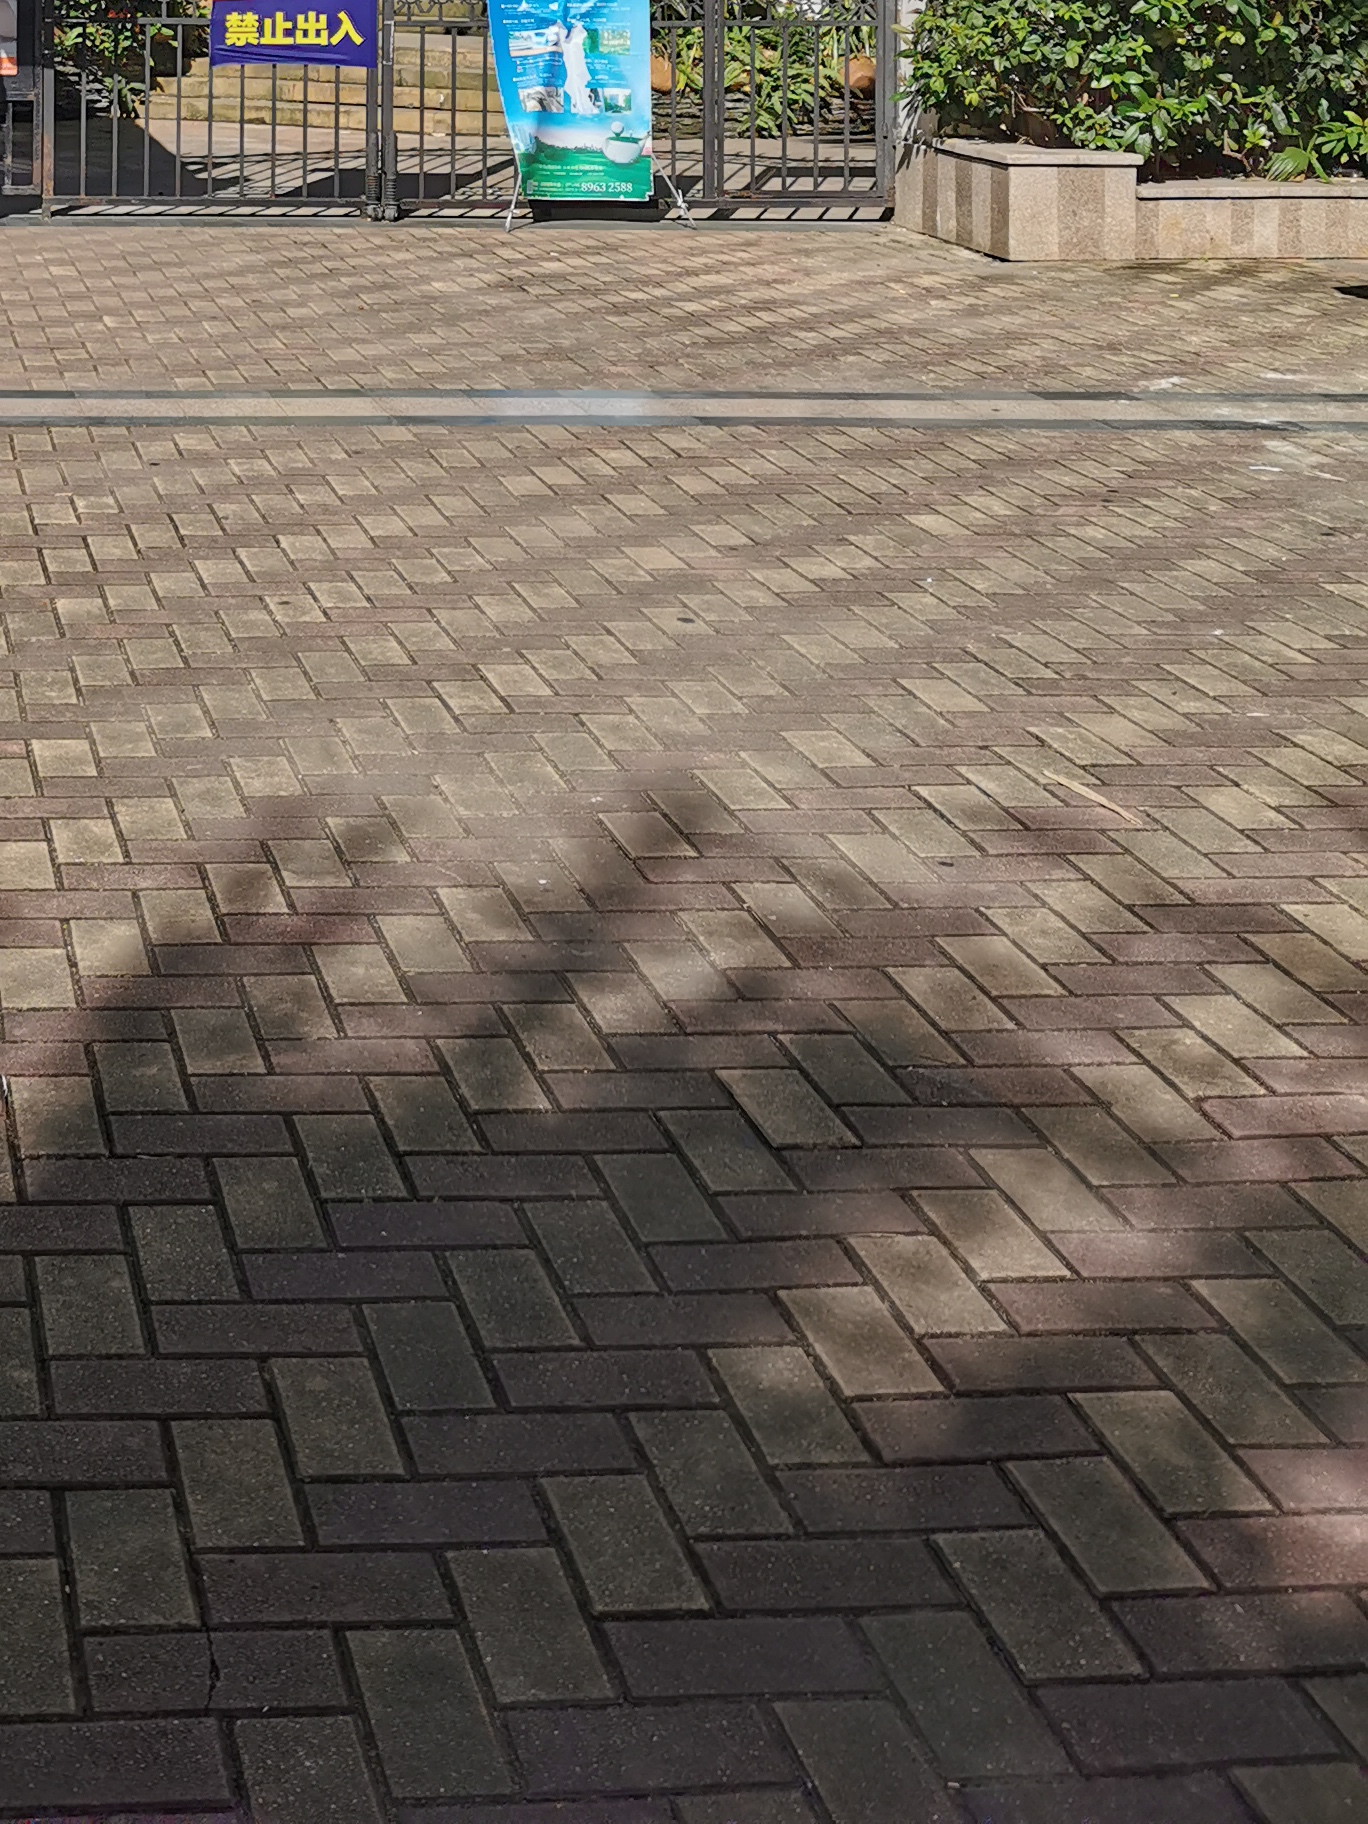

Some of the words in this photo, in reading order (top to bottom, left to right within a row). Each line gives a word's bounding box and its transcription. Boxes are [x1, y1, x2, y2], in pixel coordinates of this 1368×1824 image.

[225, 11, 365, 47] 禁止出入
[581, 182, 606, 192] 8963
[608, 182, 633, 192] 2588
